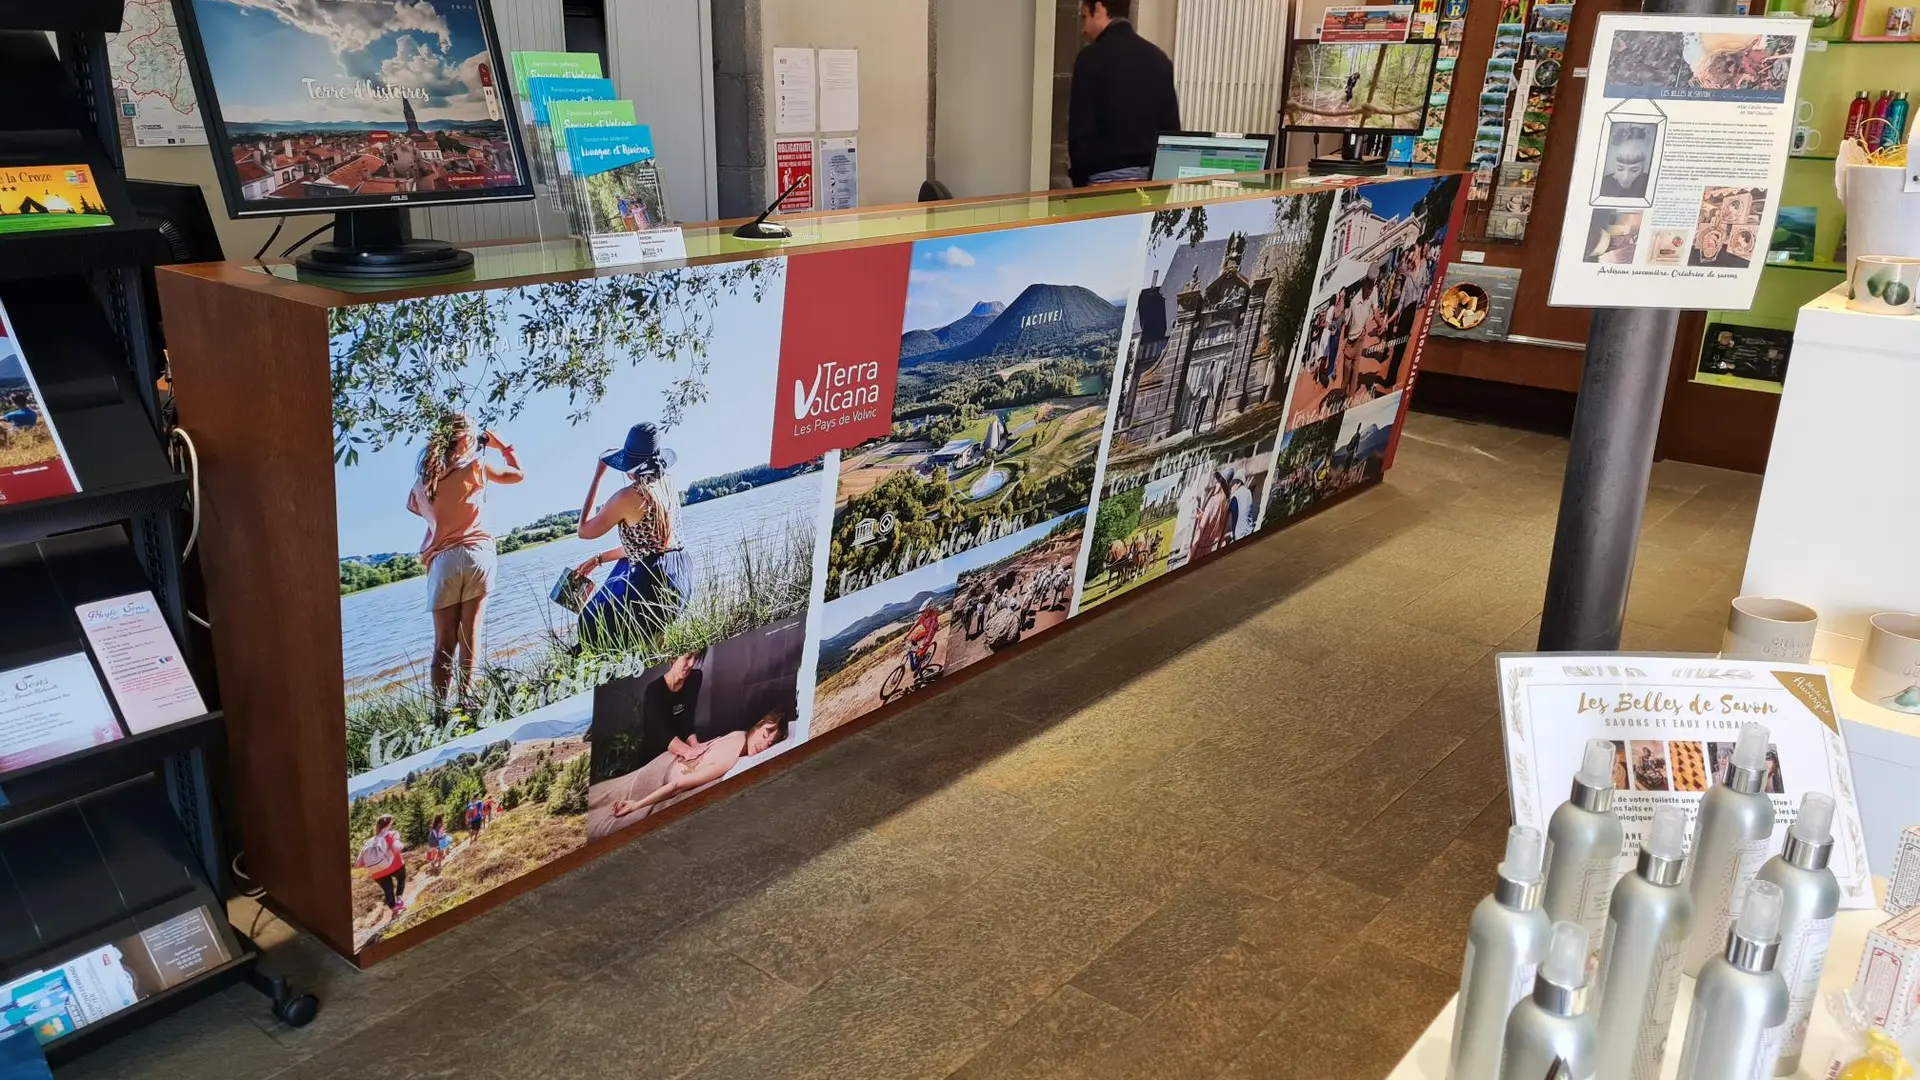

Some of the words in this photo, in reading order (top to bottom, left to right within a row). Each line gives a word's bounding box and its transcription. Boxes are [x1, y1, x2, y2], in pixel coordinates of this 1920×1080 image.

[301, 76, 349, 101] Terre
[354, 77, 430, 103] d'histoires
[580, 144, 613, 161] Limagne
[613, 144, 622, 155] et
[622, 143, 652, 156] Rivières
[777, 143, 811, 153] OBLIGATOIRE
[6, 173, 16, 183] la
[19, 171, 53, 183] Croze
[390, 194, 409, 202] ASUS
[1597, 265, 1629, 276] Artisane
[1020, 308, 1063, 329] (ACTIVE)
[1405, 276, 1443, 392] terravolcana.com
[823, 361, 879, 389] Terra
[794, 364, 879, 420] Volcana
[793, 424, 812, 436] Les
[814, 418, 837, 432] Pays
[838, 414, 850, 425] de
[853, 406, 877, 422] Volvic
[838, 559, 893, 598] terre
[15, 674, 49, 691] Sens
[1577, 691, 1610, 716] Les
[1613, 691, 1683, 716] Belles
[1689, 693, 1714, 716] de
[1720, 694, 1779, 716] Savon
[1792, 676, 1831, 717] Auvergne
[1605, 718, 1650, 728] SAVONS
[1655, 718, 1668, 728] ET
[1673, 719, 1700, 729] EAUX
[1617, 796, 1628, 804] de
[1651, 796, 1679, 805] toilette
[1624, 804, 1642, 812] faits
